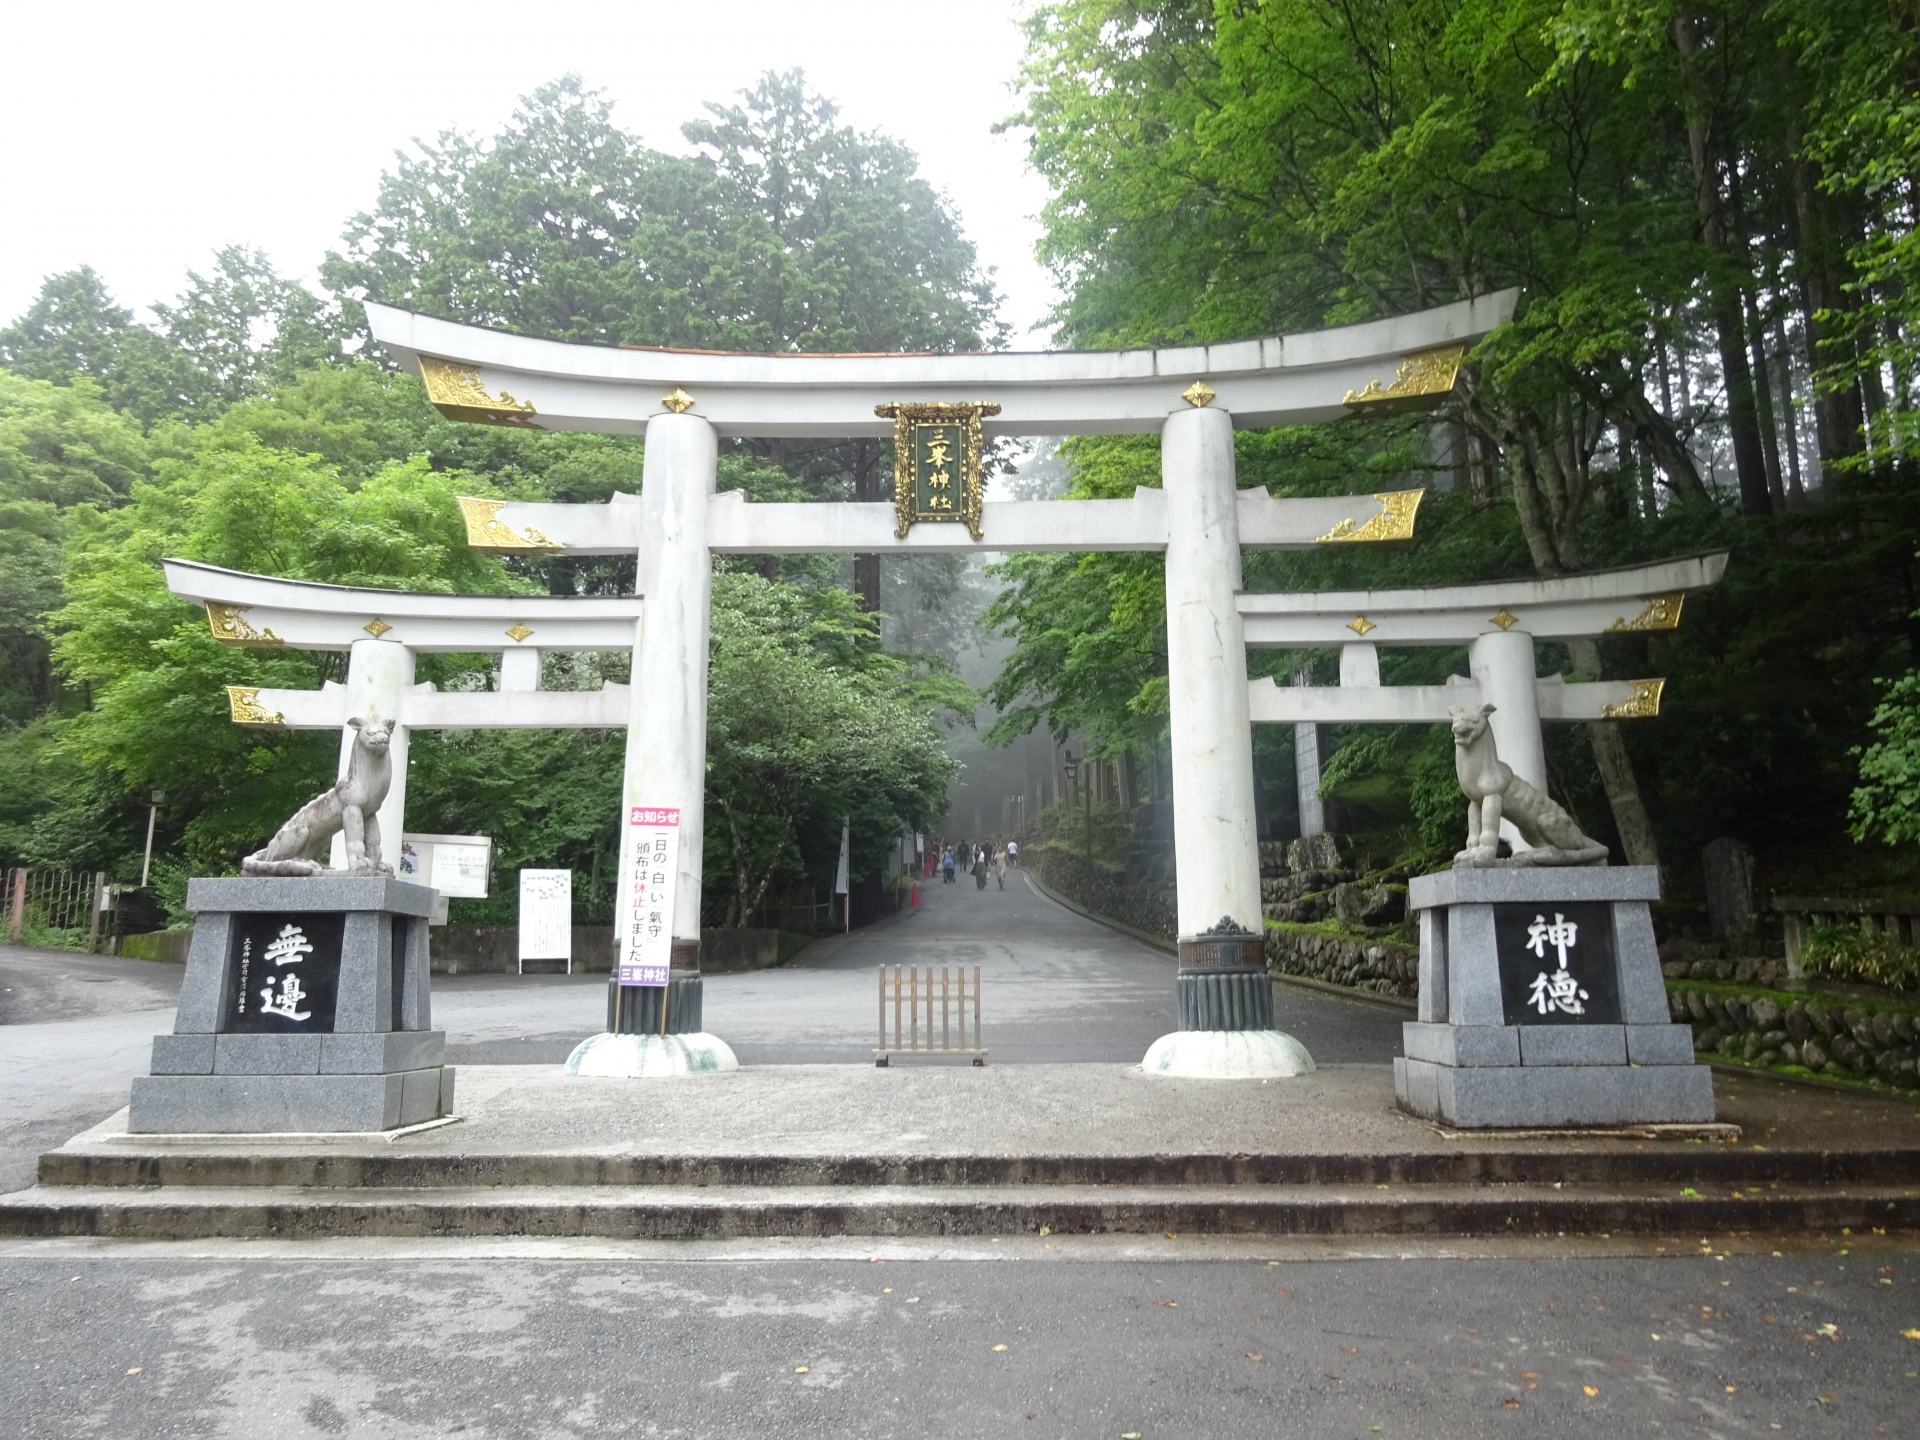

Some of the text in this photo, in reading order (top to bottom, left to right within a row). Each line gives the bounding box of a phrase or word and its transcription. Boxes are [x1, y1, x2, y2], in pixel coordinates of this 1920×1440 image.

[631, 810, 679, 824] お知らせ
[629, 842, 650, 962] 頒布は休止しました
